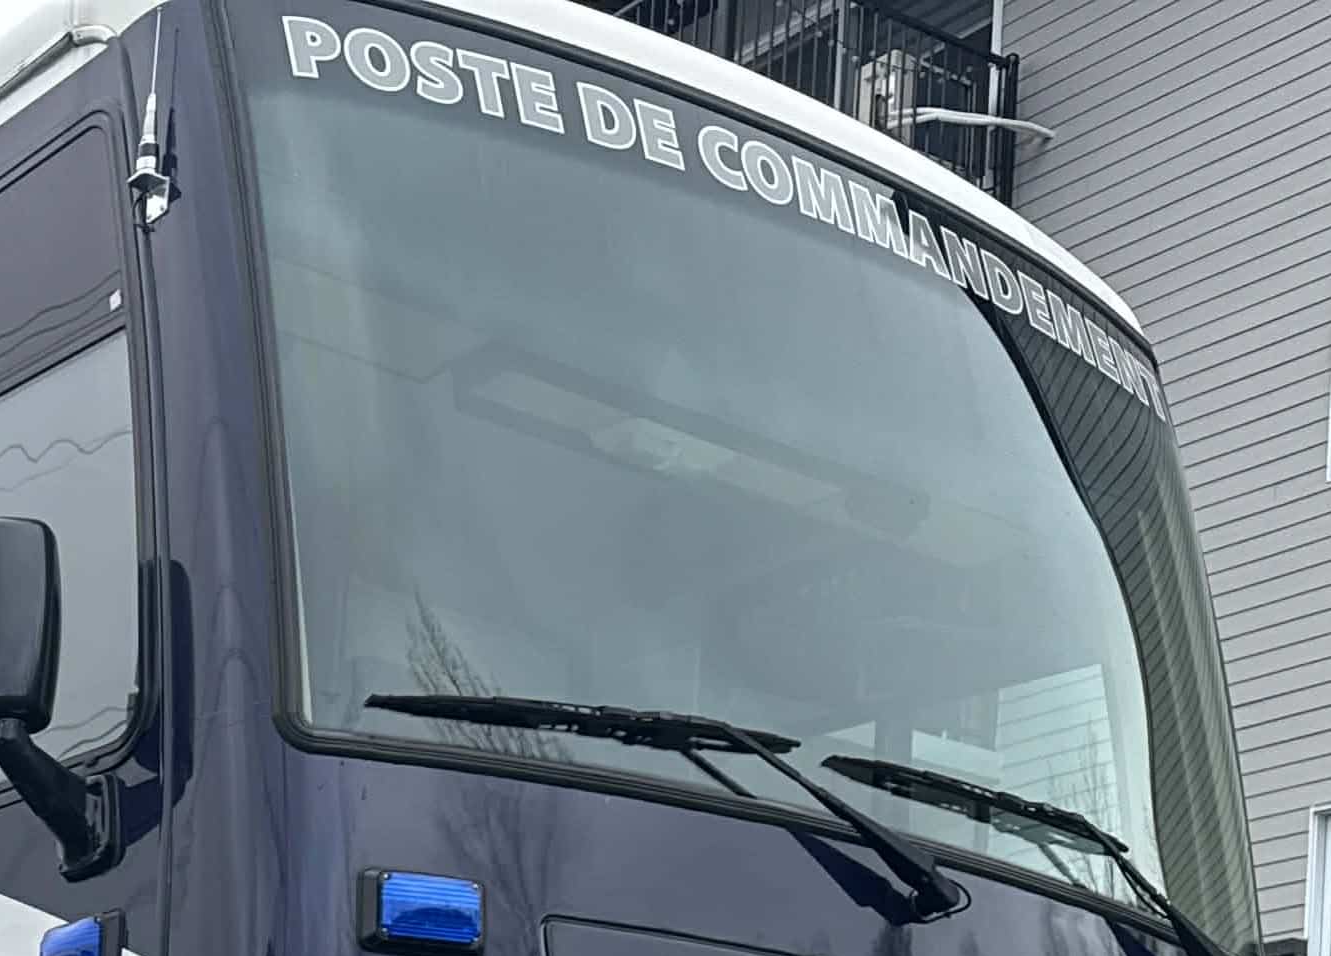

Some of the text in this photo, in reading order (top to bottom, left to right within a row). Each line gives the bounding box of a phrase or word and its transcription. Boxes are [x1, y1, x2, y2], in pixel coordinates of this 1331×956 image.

[282, 15, 1167, 424] POSTE DE COMMANDEMENT
